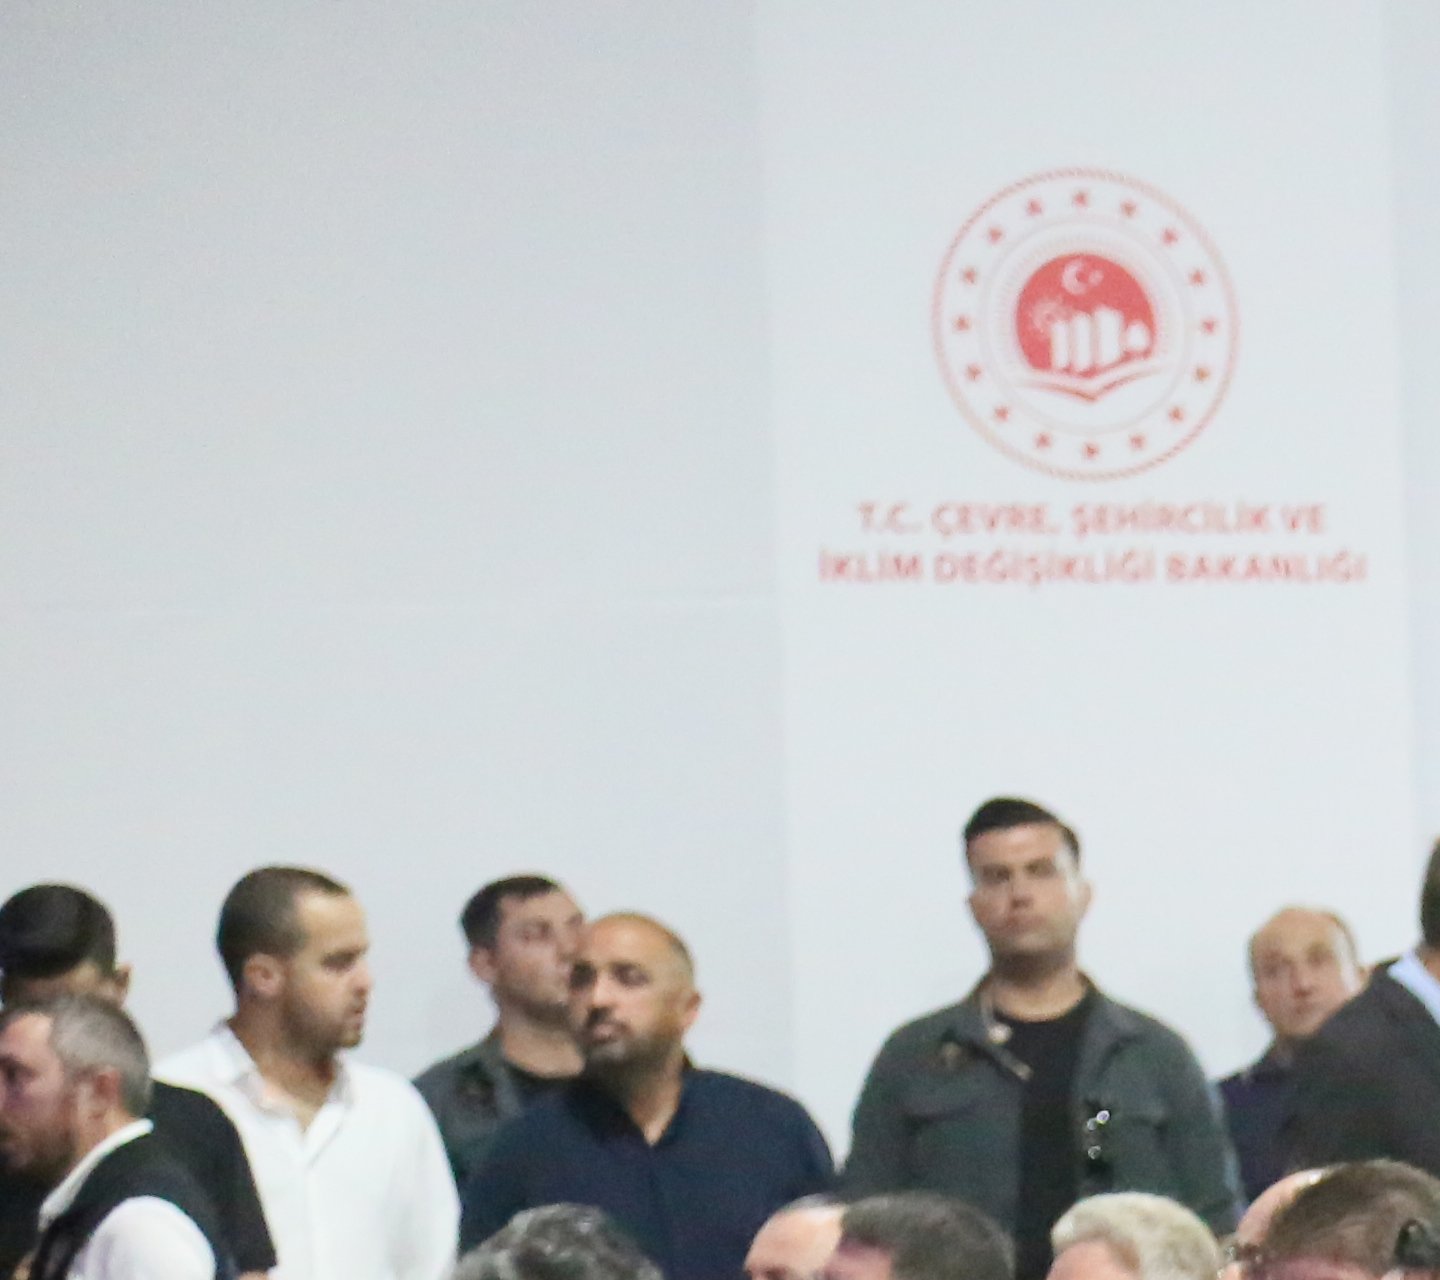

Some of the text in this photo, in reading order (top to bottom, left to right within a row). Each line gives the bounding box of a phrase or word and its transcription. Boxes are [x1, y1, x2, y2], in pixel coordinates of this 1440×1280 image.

[857, 503, 923, 534] T.C.
[1070, 499, 1269, 541] ŞEHİRCİLİK
[1285, 503, 1327, 533] VE
[818, 547, 1367, 589] İKLİM DEĞİŞİKLİĞİ BAKANLIĞI
